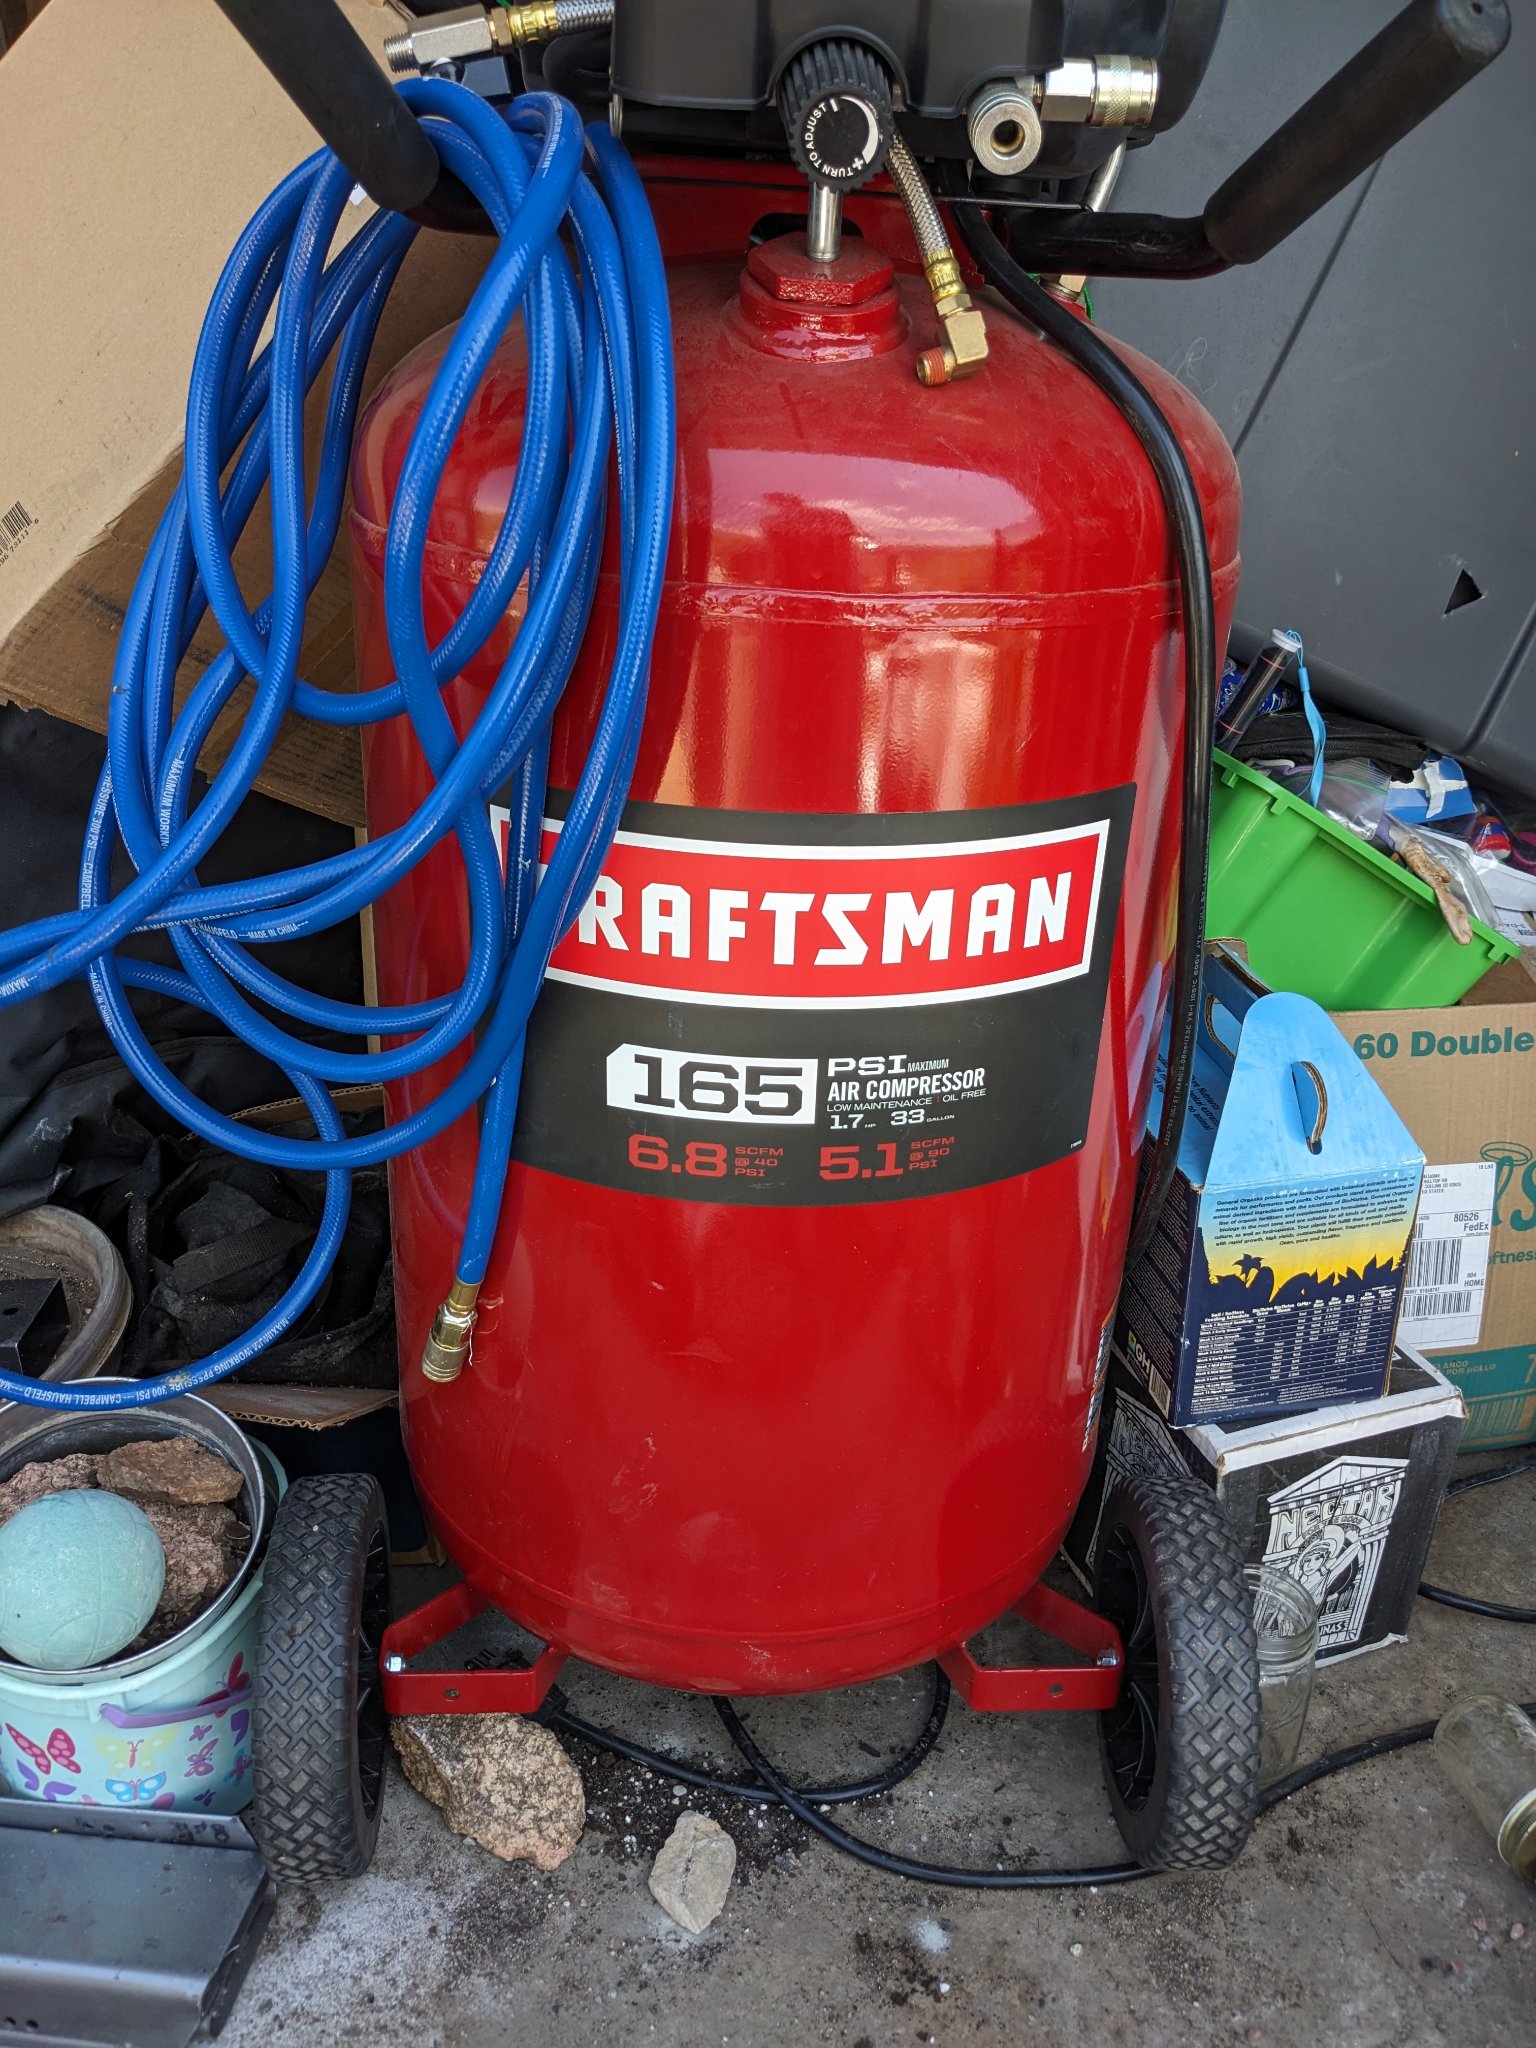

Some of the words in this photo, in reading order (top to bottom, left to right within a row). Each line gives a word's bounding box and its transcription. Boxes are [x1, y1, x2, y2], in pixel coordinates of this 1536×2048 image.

[805, 102, 826, 148] ADJUST
[809, 152, 821, 168] TO
[822, 165, 853, 177] TURN
[94, 769, 112, 818] RESSURE
[91, 818, 102, 837] 300
[160, 807, 171, 850] WORKIN
[87, 833, 98, 849] PSI
[82, 862, 94, 909] CAMPBELL
[540, 865, 1072, 966] RAFTSMAN
[1354, 1032, 1398, 1060] 60
[1410, 1026, 1535, 1056] Double
[827, 1054, 907, 1077] PSI
[907, 1058, 950, 1073] MAXIMUM
[634, 1054, 804, 1116] 165
[827, 1080, 859, 1102] AIR
[866, 1067, 985, 1100] COMPRESSOR
[826, 1104, 852, 1112] LOW
[854, 1097, 933, 1111] MAINTENANCE
[942, 1093, 959, 1103] OIL
[961, 1088, 987, 1100] FREE
[830, 1113, 864, 1130] 1.7
[890, 1108, 925, 1126] 33
[926, 1114, 955, 1123] GALLON
[628, 1133, 728, 1178] 6.8
[734, 1146, 784, 1156] SCFM
[754, 1158, 778, 1167] 40
[820, 1142, 904, 1181] 5.1
[911, 1136, 955, 1150] SCFM
[928, 1148, 950, 1158] 90
[734, 1168, 766, 1177] PSI
[909, 1160, 938, 1171] PSI
[1453, 1212, 1479, 1222] 80526
[1464, 1222, 1489, 1231] FedEx
[1464, 1278, 1485, 1287] HOME
[252, 1316, 289, 1351] MAXIMUM
[1136, 1343, 1151, 1374] GH
[24, 1387, 72, 1404] HAUSFELD
[75, 1394, 122, 1405] CAMPBELL
[136, 1390, 150, 1401] PSI
[152, 1385, 168, 1397] 300
